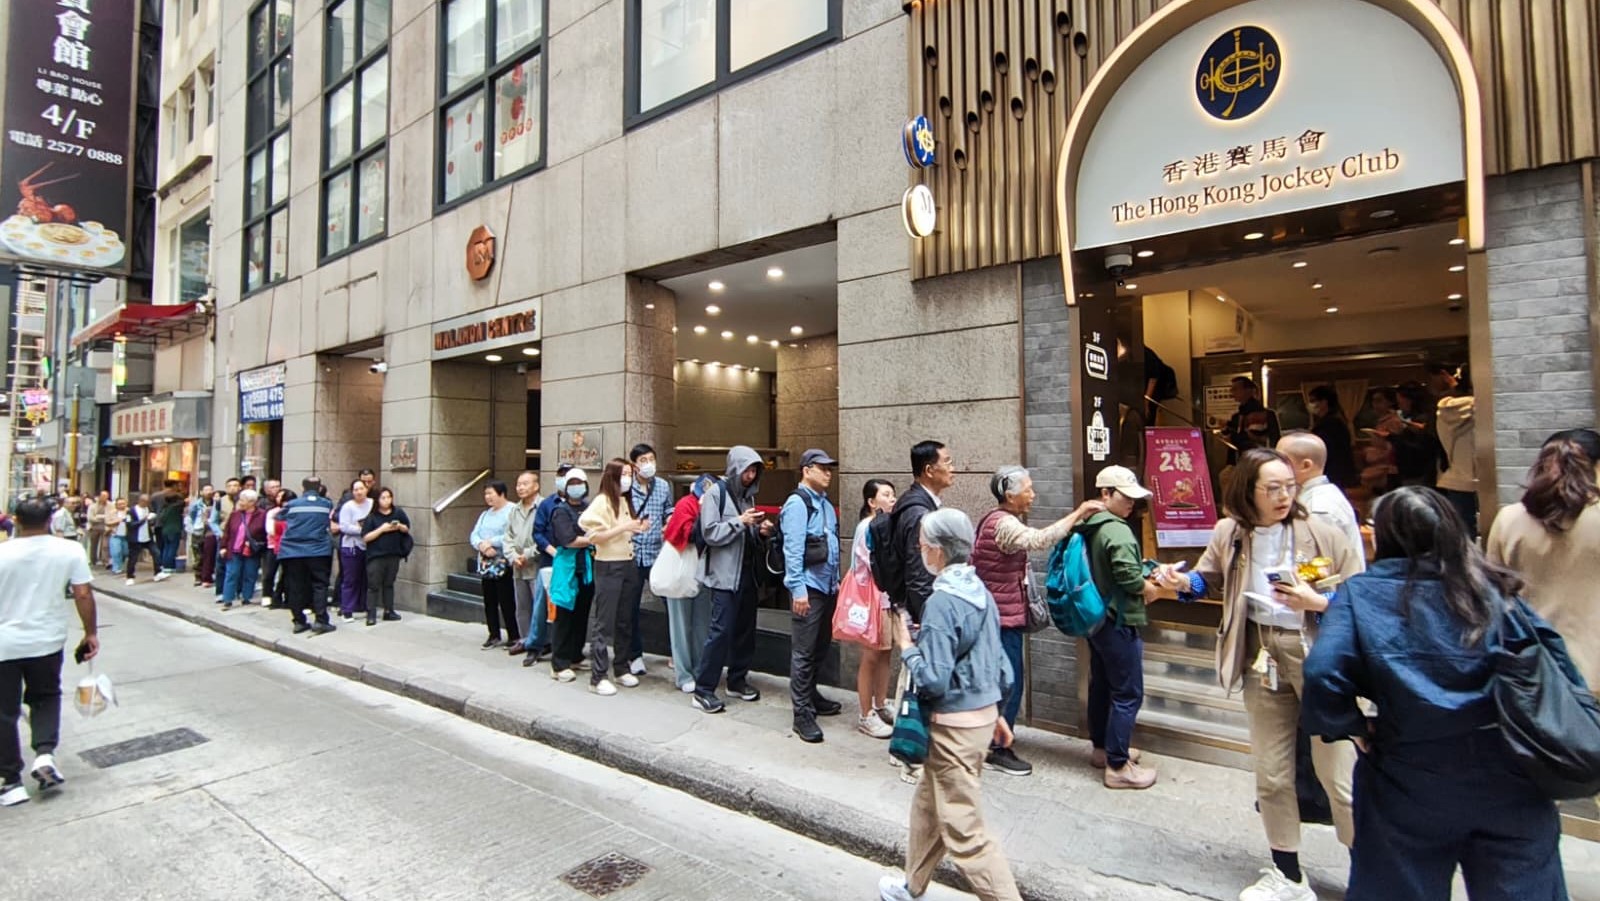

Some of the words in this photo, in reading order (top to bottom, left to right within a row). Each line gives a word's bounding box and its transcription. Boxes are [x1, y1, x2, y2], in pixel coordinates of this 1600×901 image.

[37, 67, 47, 75] LI
[50, 71, 69, 81] BAO
[72, 76, 103, 90] HOUSE
[41, 103, 96, 140] 4/F
[8, 129, 43, 149] 電話
[47, 139, 84, 157] 2577
[87, 148, 123, 165] 0888
[1162, 128, 1328, 184] 香港賽馬會
[1111, 203, 1146, 224] The
[1149, 191, 1198, 217] Hong
[1203, 181, 1256, 207] Kong
[1258, 164, 1336, 200] Jockey
[1341, 147, 1401, 179] Club
[487, 308, 536, 339] CENTRE
